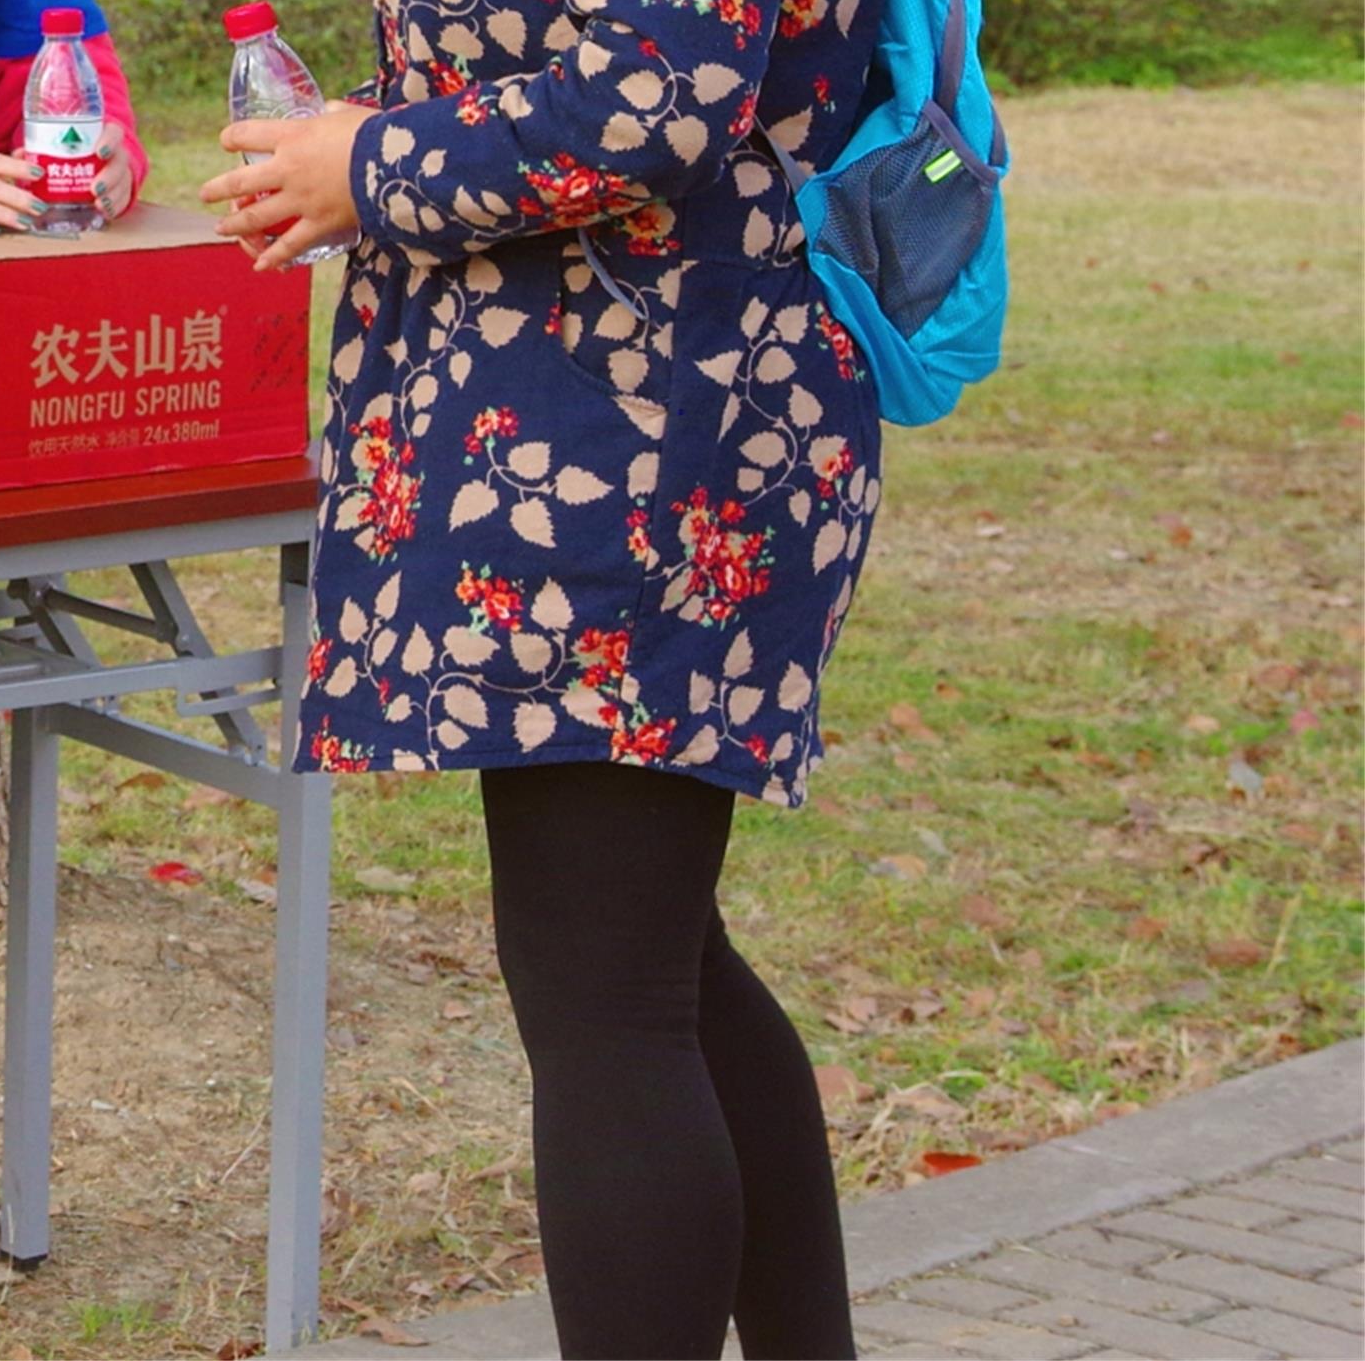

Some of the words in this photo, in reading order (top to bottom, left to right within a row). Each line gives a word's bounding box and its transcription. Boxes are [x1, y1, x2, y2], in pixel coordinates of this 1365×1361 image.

[30, 308, 223, 389] 农夫山泉
[30, 390, 125, 429] NONGFU
[134, 379, 221, 416] SPRING
